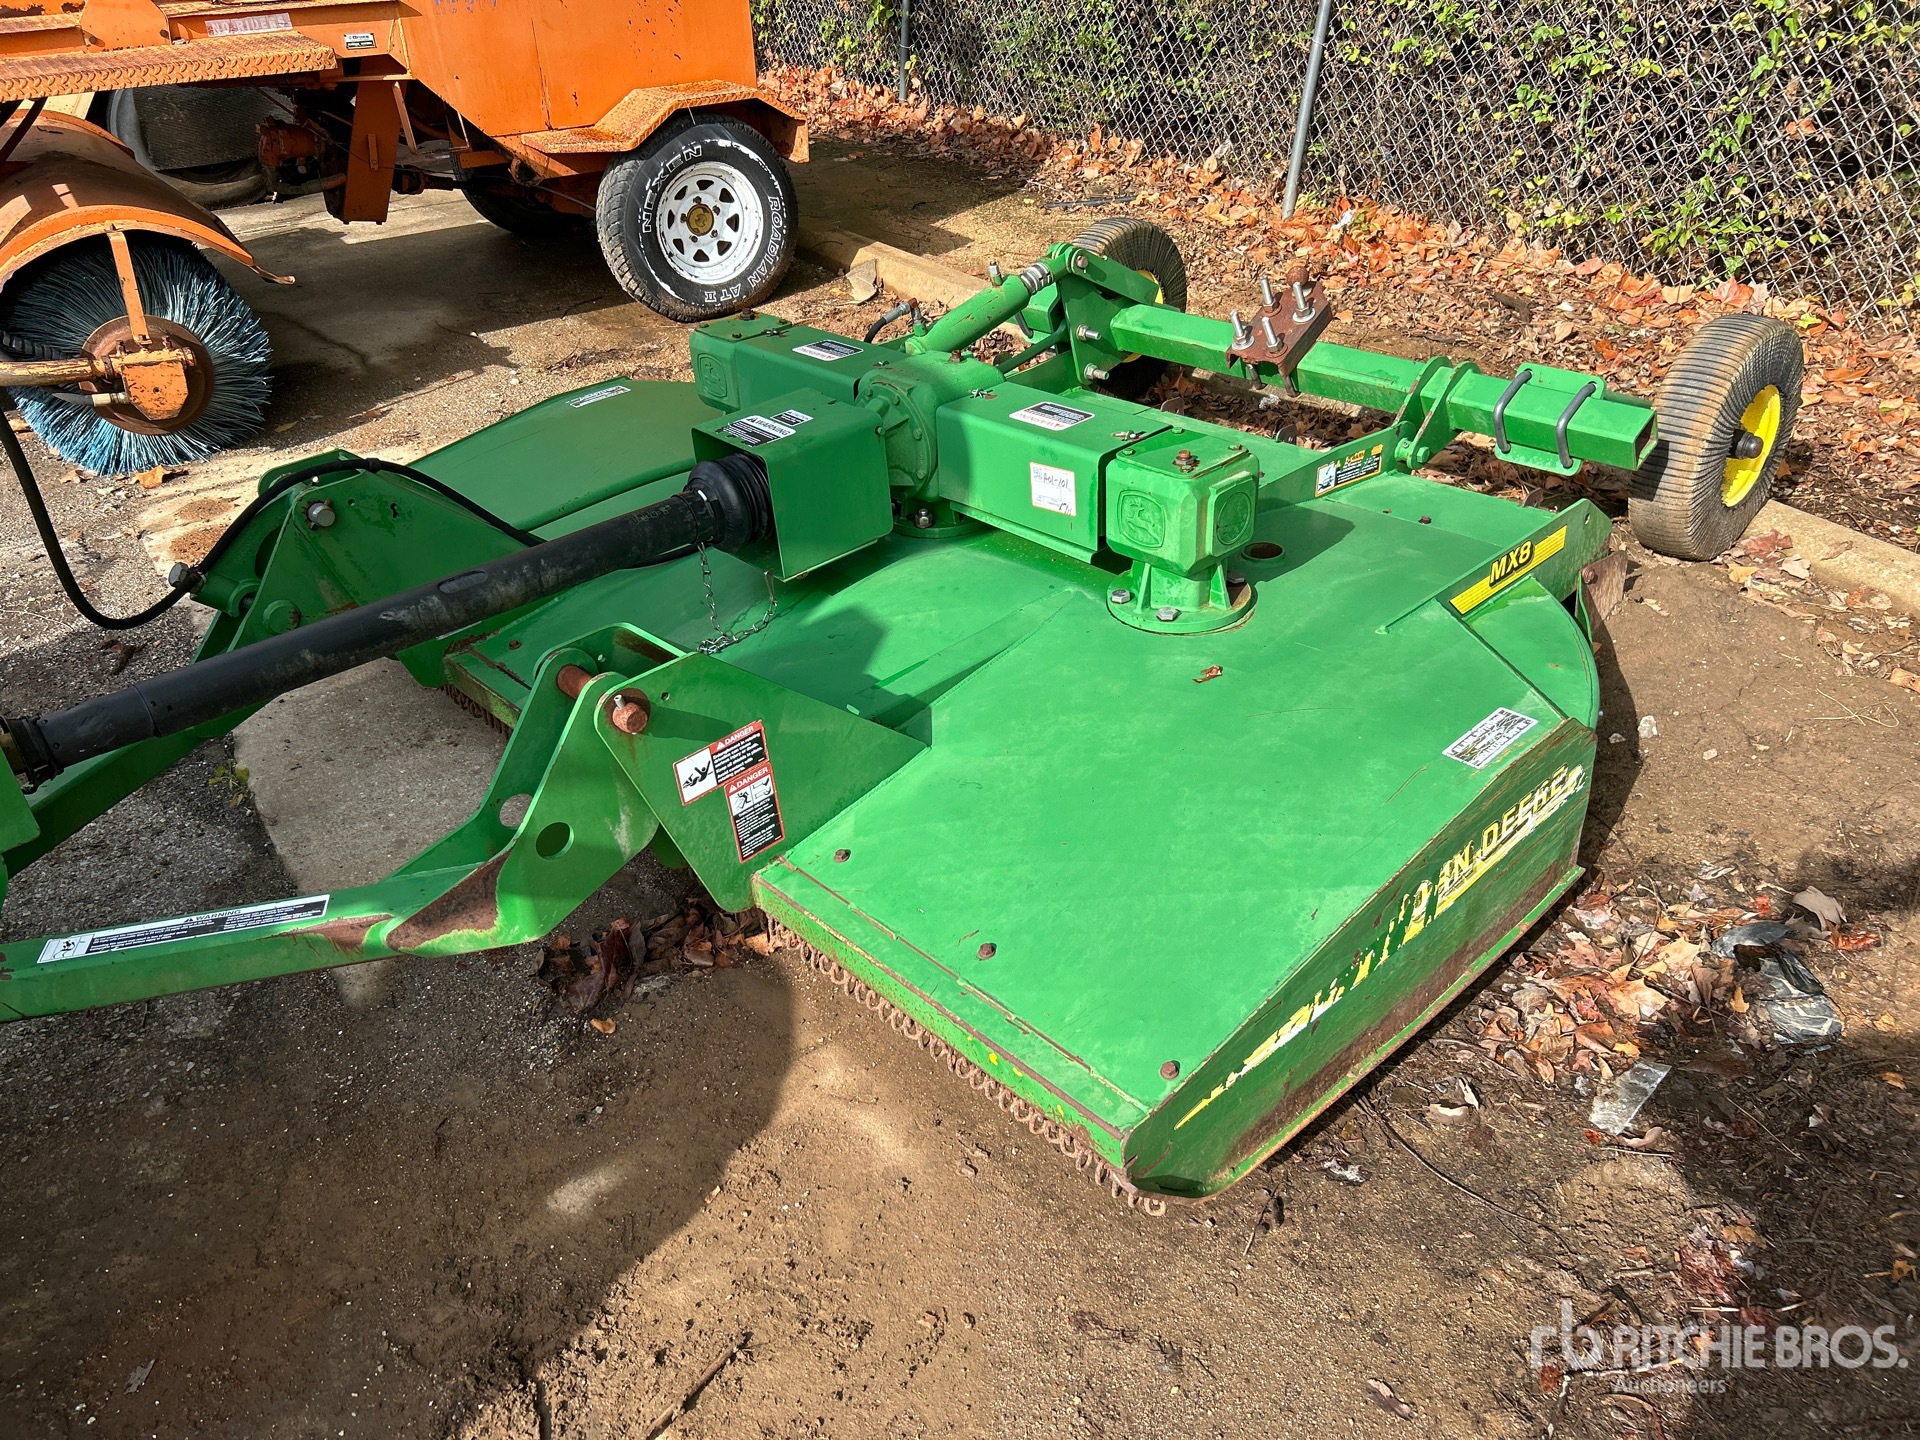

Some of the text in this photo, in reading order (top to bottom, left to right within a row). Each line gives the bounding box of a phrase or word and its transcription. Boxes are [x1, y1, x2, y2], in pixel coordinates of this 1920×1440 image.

[641, 145, 702, 233] NEXEN
[748, 196, 783, 288] ROADIAN
[720, 284, 741, 302] AT
[755, 419, 791, 436] WARNING
[1489, 541, 1533, 586] MX8
[724, 726, 754, 744] DANGER
[736, 767, 768, 788] DANGER
[196, 909, 242, 921] WARNING
